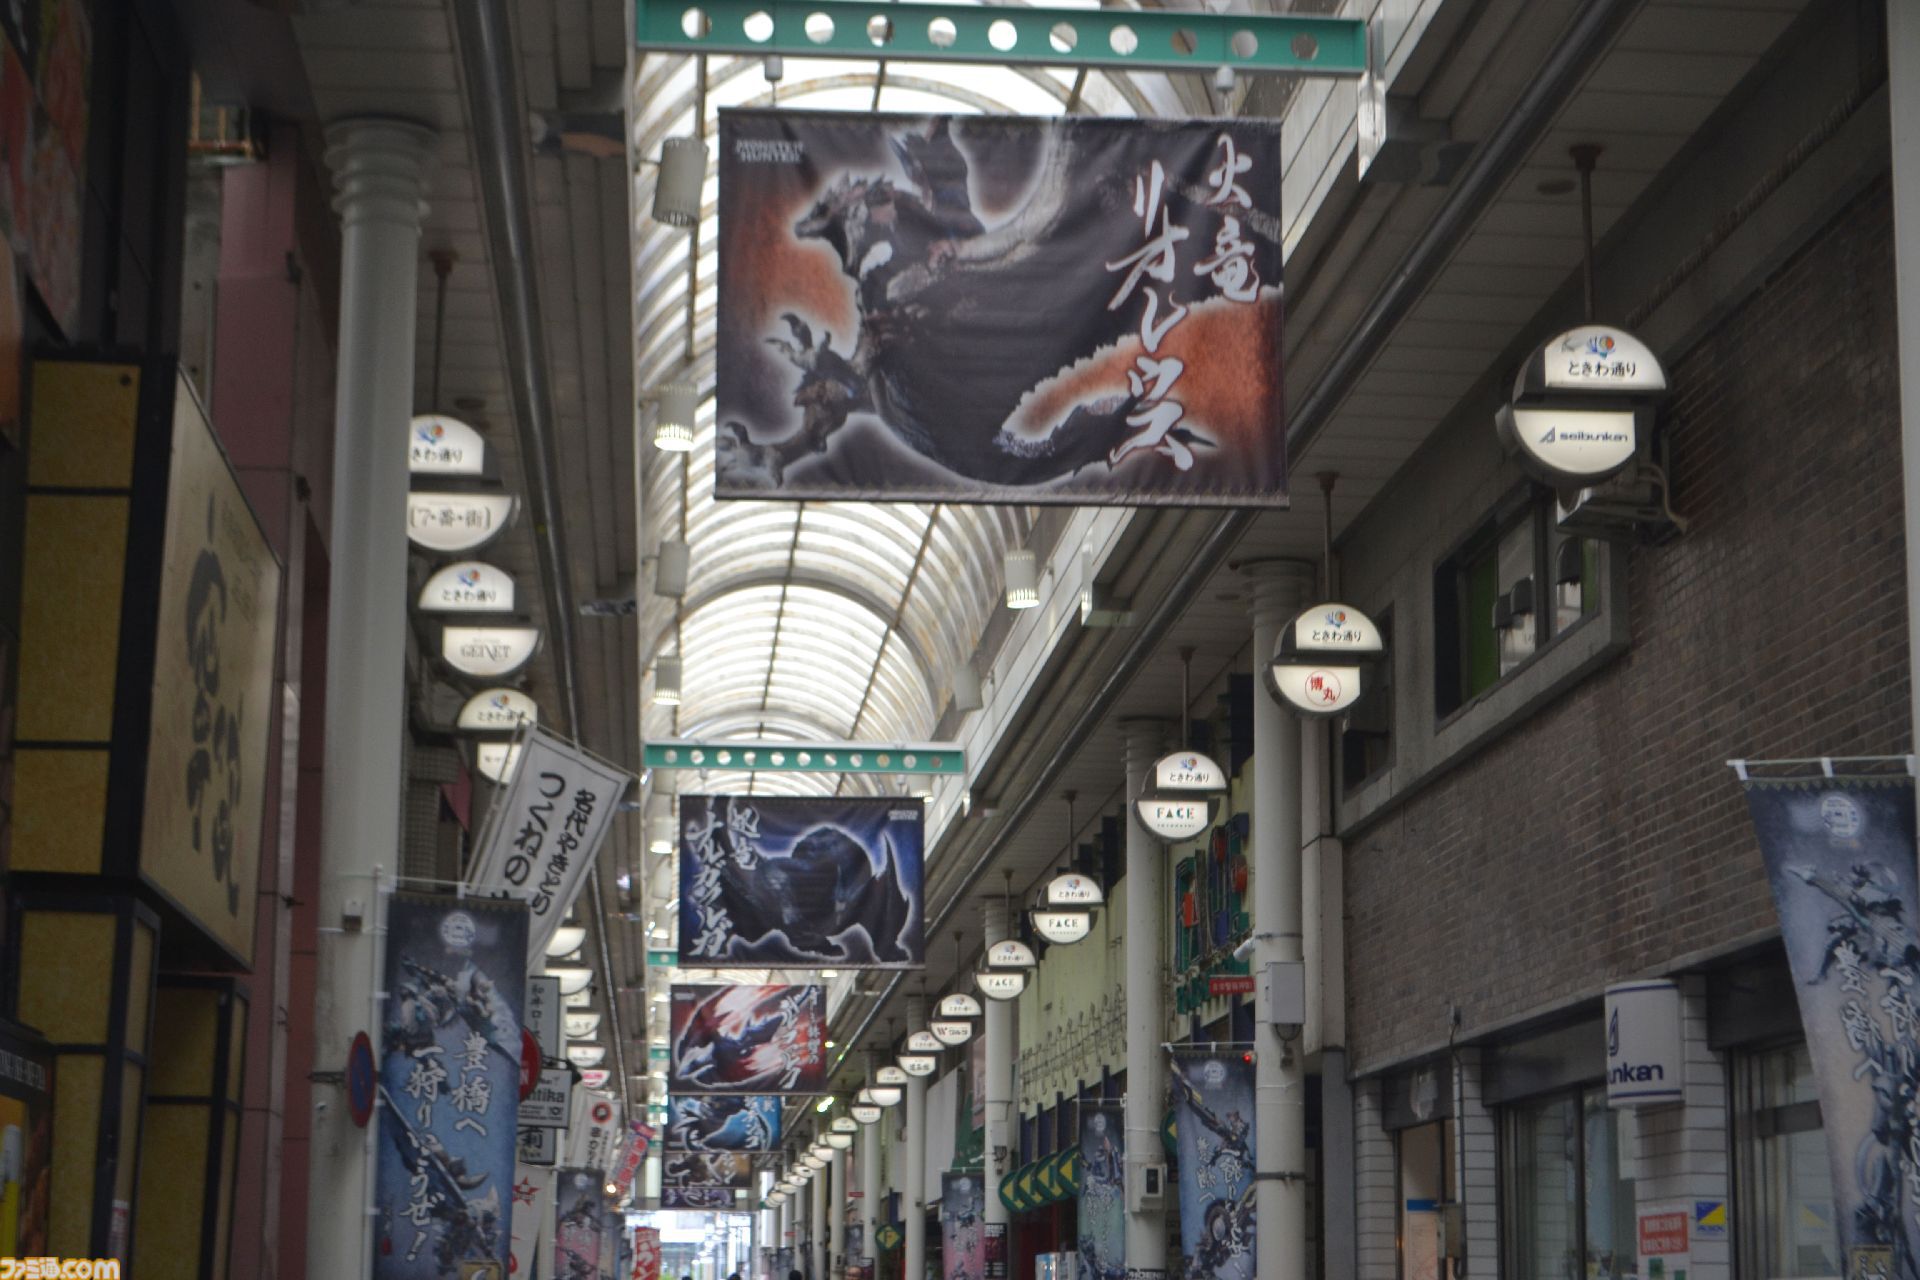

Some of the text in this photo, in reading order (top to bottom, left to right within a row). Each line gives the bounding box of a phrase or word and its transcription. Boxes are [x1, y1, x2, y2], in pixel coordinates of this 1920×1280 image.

[1105, 160, 1194, 473] リオレウス
[1568, 361, 1636, 378] ときわ通り
[1560, 430, 1628, 442] seibunkan
[411, 448, 463, 463] きわ通り
[442, 589, 496, 602] ときわ通り
[1312, 630, 1361, 642] ときわ通り
[1169, 772, 1210, 783] ときわ通り
[1156, 806, 1195, 819] FACE
[491, 771, 567, 899] つくねの
[684, 810, 733, 957] ナルガクルガ
[1058, 890, 1090, 899] ときわ通り
[1049, 919, 1078, 928] FACE
[989, 978, 1014, 986] FACE
[452, 1032, 491, 1137] 豊橋へ
[525, 1088, 565, 1104] ntika
